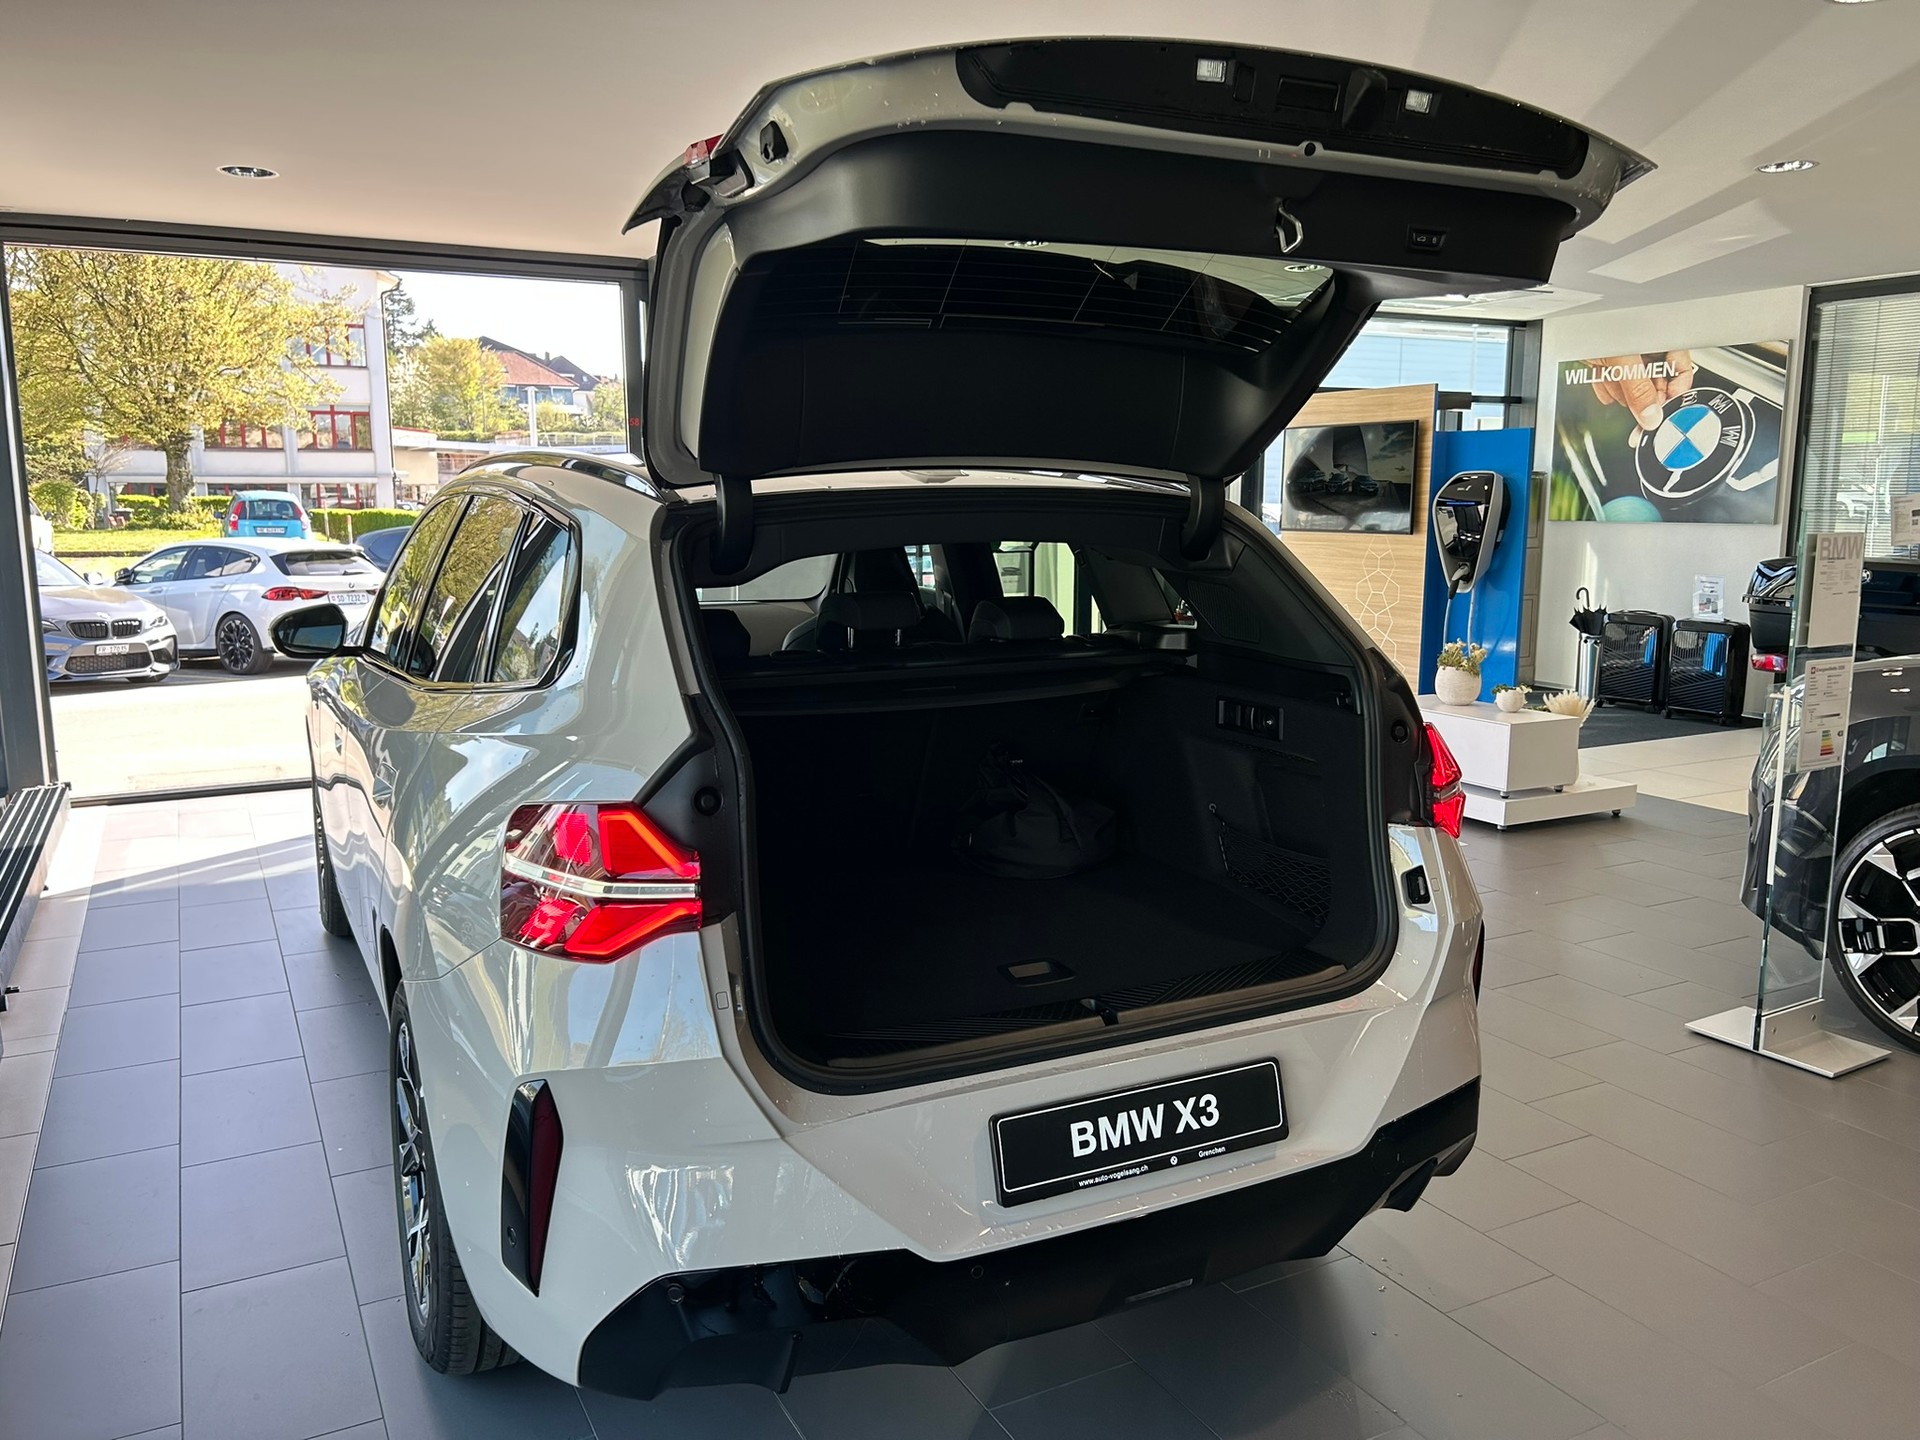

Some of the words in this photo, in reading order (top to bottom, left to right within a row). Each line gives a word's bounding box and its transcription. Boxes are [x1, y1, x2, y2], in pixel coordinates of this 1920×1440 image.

[1565, 361, 1679, 385] WILLKOMMEN.
[1820, 535, 1864, 561] BMW
[1070, 1103, 1165, 1158] BMW
[1172, 1093, 1220, 1135] X3
[1078, 1164, 1149, 1187] www.auto-vogelsang.ch
[1198, 1146, 1226, 1158] Grenchen
